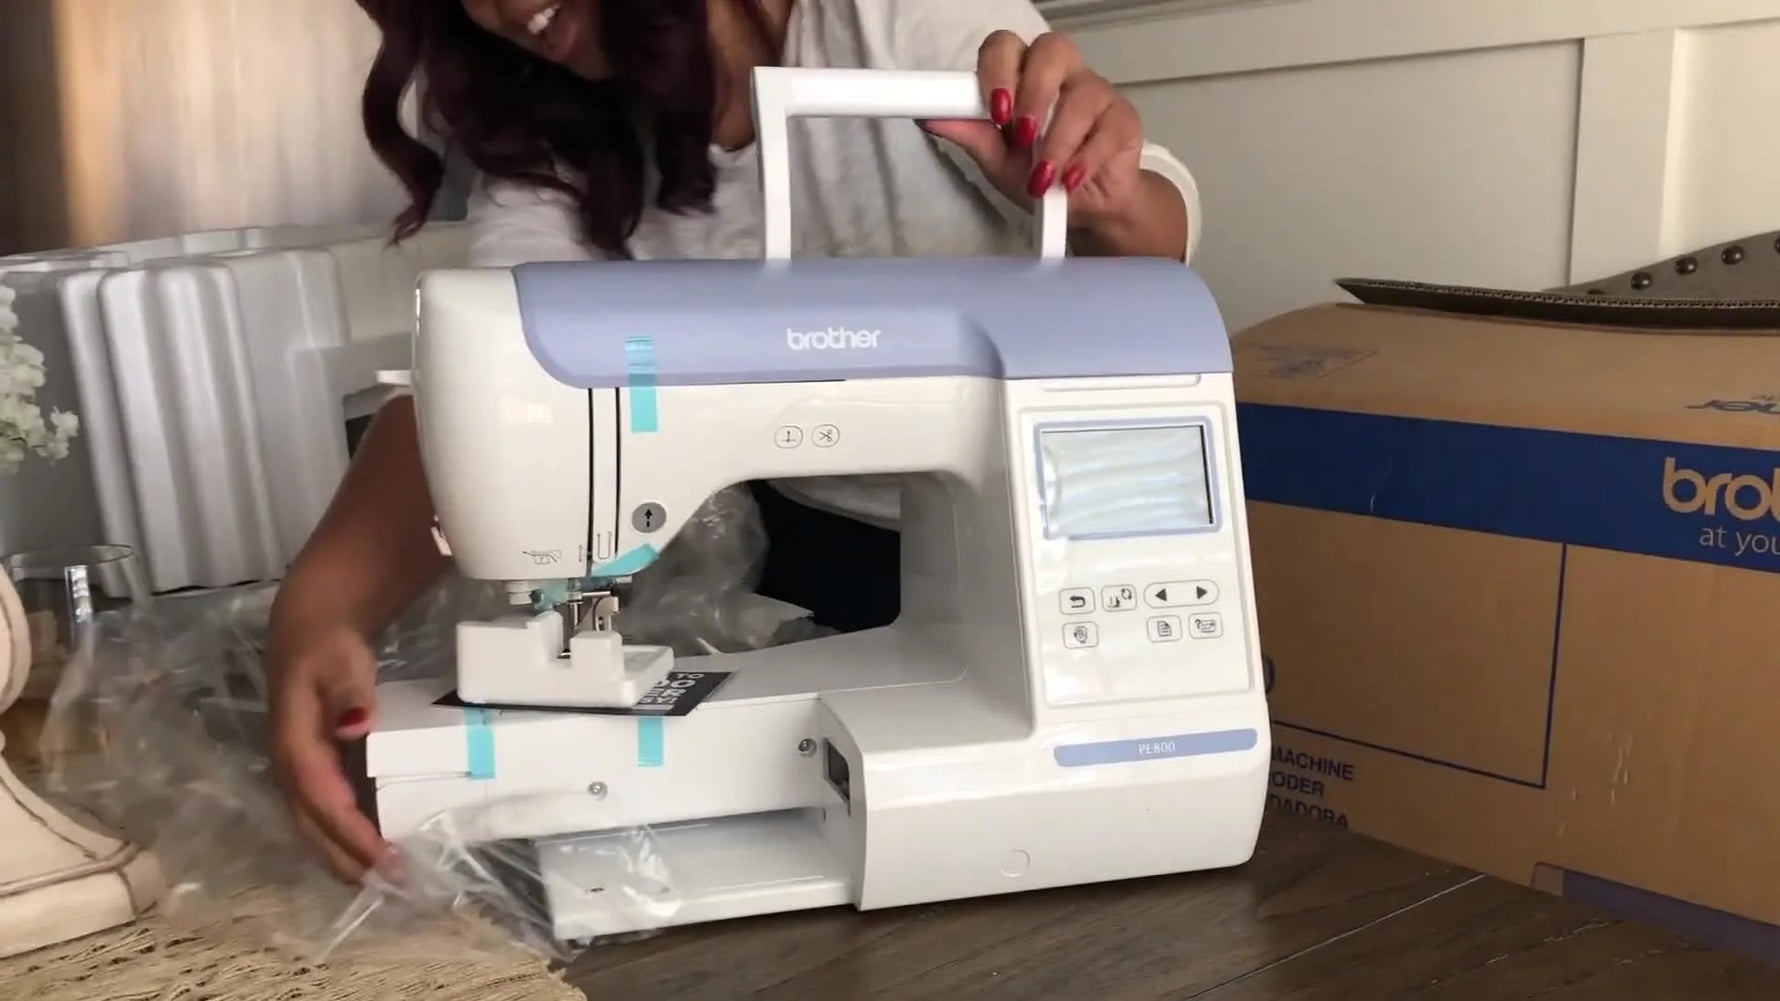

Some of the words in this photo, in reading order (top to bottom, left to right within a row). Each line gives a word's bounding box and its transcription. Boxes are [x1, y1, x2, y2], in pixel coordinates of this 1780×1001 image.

[786, 326, 882, 351] brother
[1700, 526, 1727, 548] at
[1138, 740, 1176, 755] PE800
[1271, 770, 1325, 797] ODER
[1269, 793, 1349, 830] DADORA
